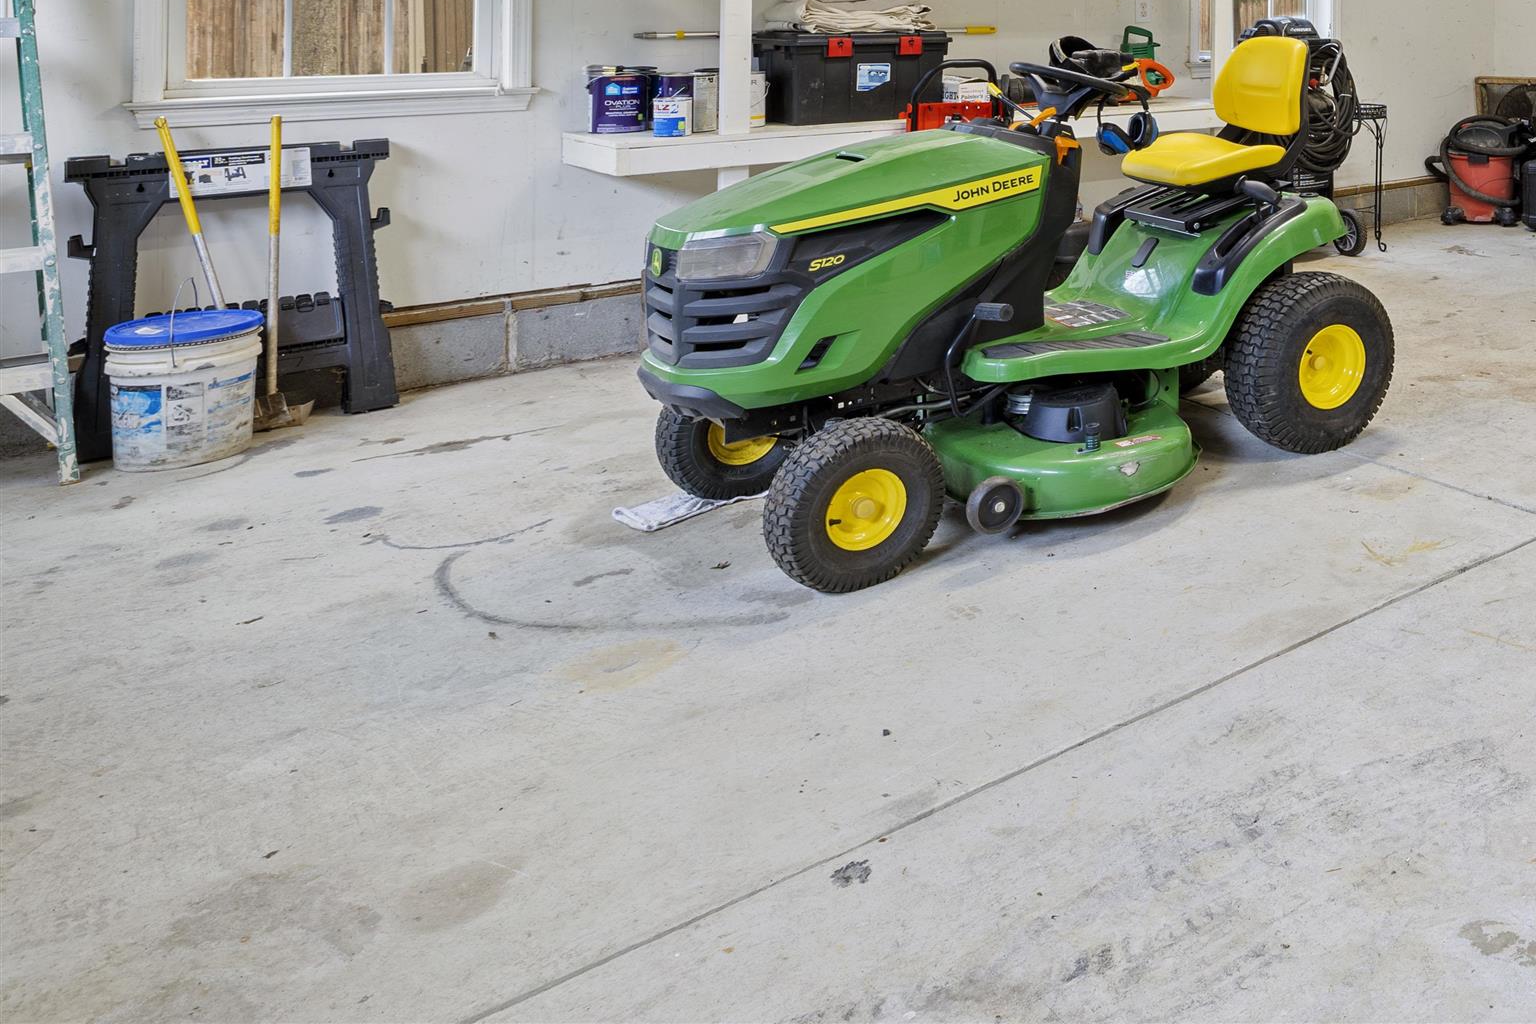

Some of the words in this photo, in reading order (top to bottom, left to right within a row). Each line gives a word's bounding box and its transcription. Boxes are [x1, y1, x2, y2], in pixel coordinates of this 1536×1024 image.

[953, 185, 989, 202] JOHN
[992, 174, 1034, 192] DEERE
[808, 254, 846, 272] S120
